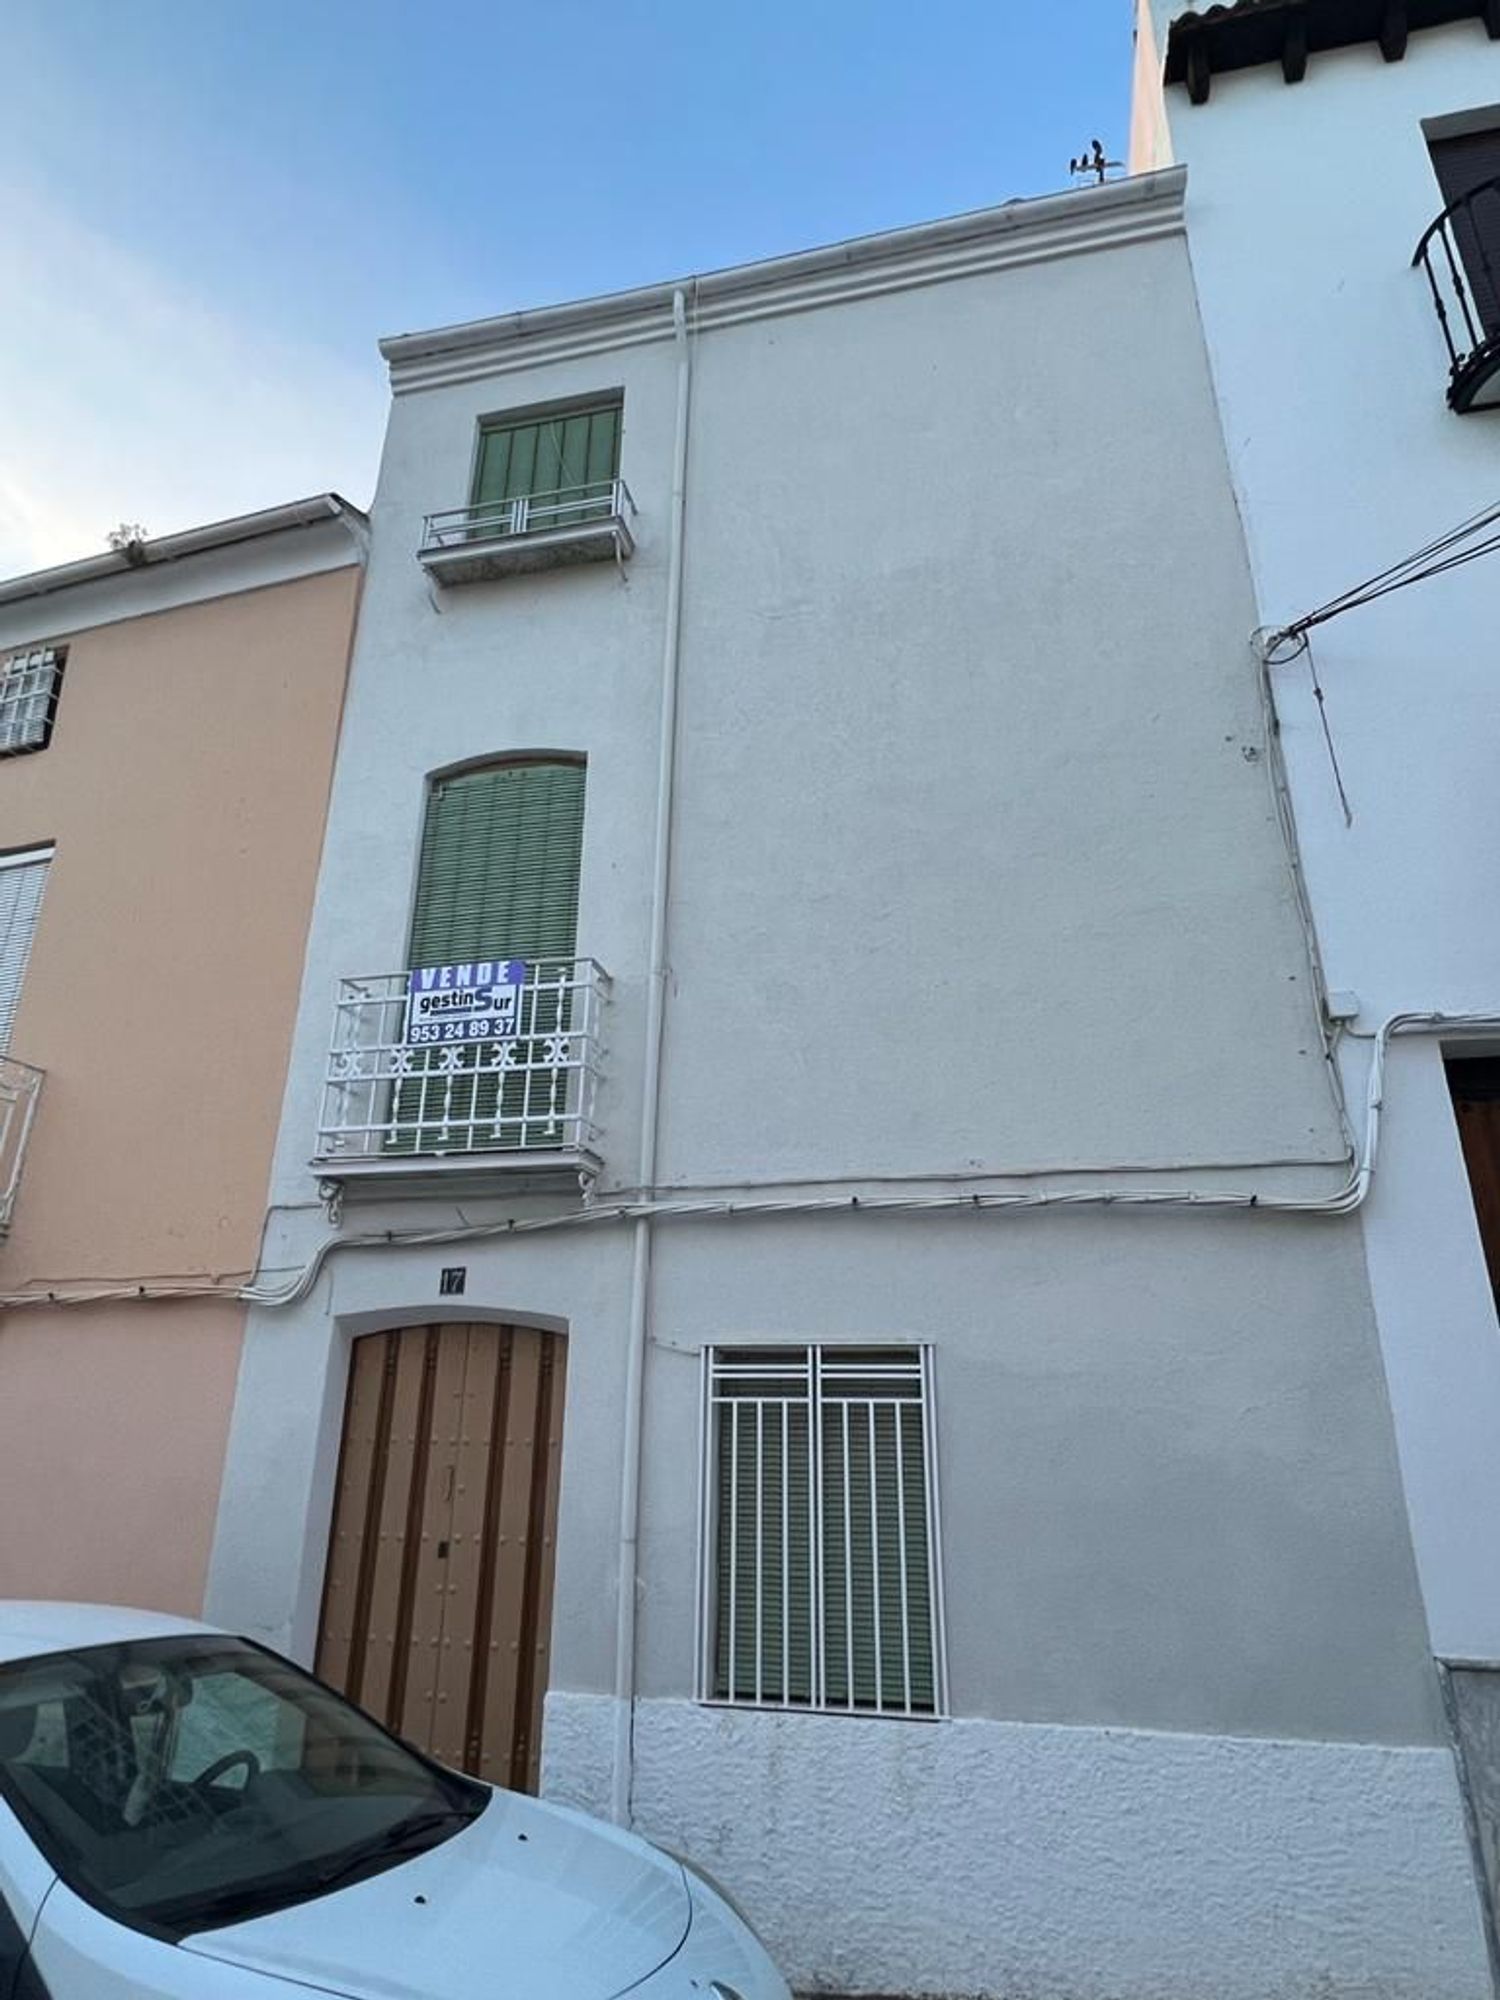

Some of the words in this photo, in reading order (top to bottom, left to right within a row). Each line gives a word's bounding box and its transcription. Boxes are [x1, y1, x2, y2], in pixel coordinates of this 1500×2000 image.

[420, 961, 510, 989] VENDE
[420, 987, 511, 1014] gestinSur
[410, 1025, 440, 1042] 953
[444, 1022, 464, 1039] 24
[468, 1019, 489, 1036] 89
[493, 1018, 514, 1035] 37
[442, 1271, 463, 1293] 17
